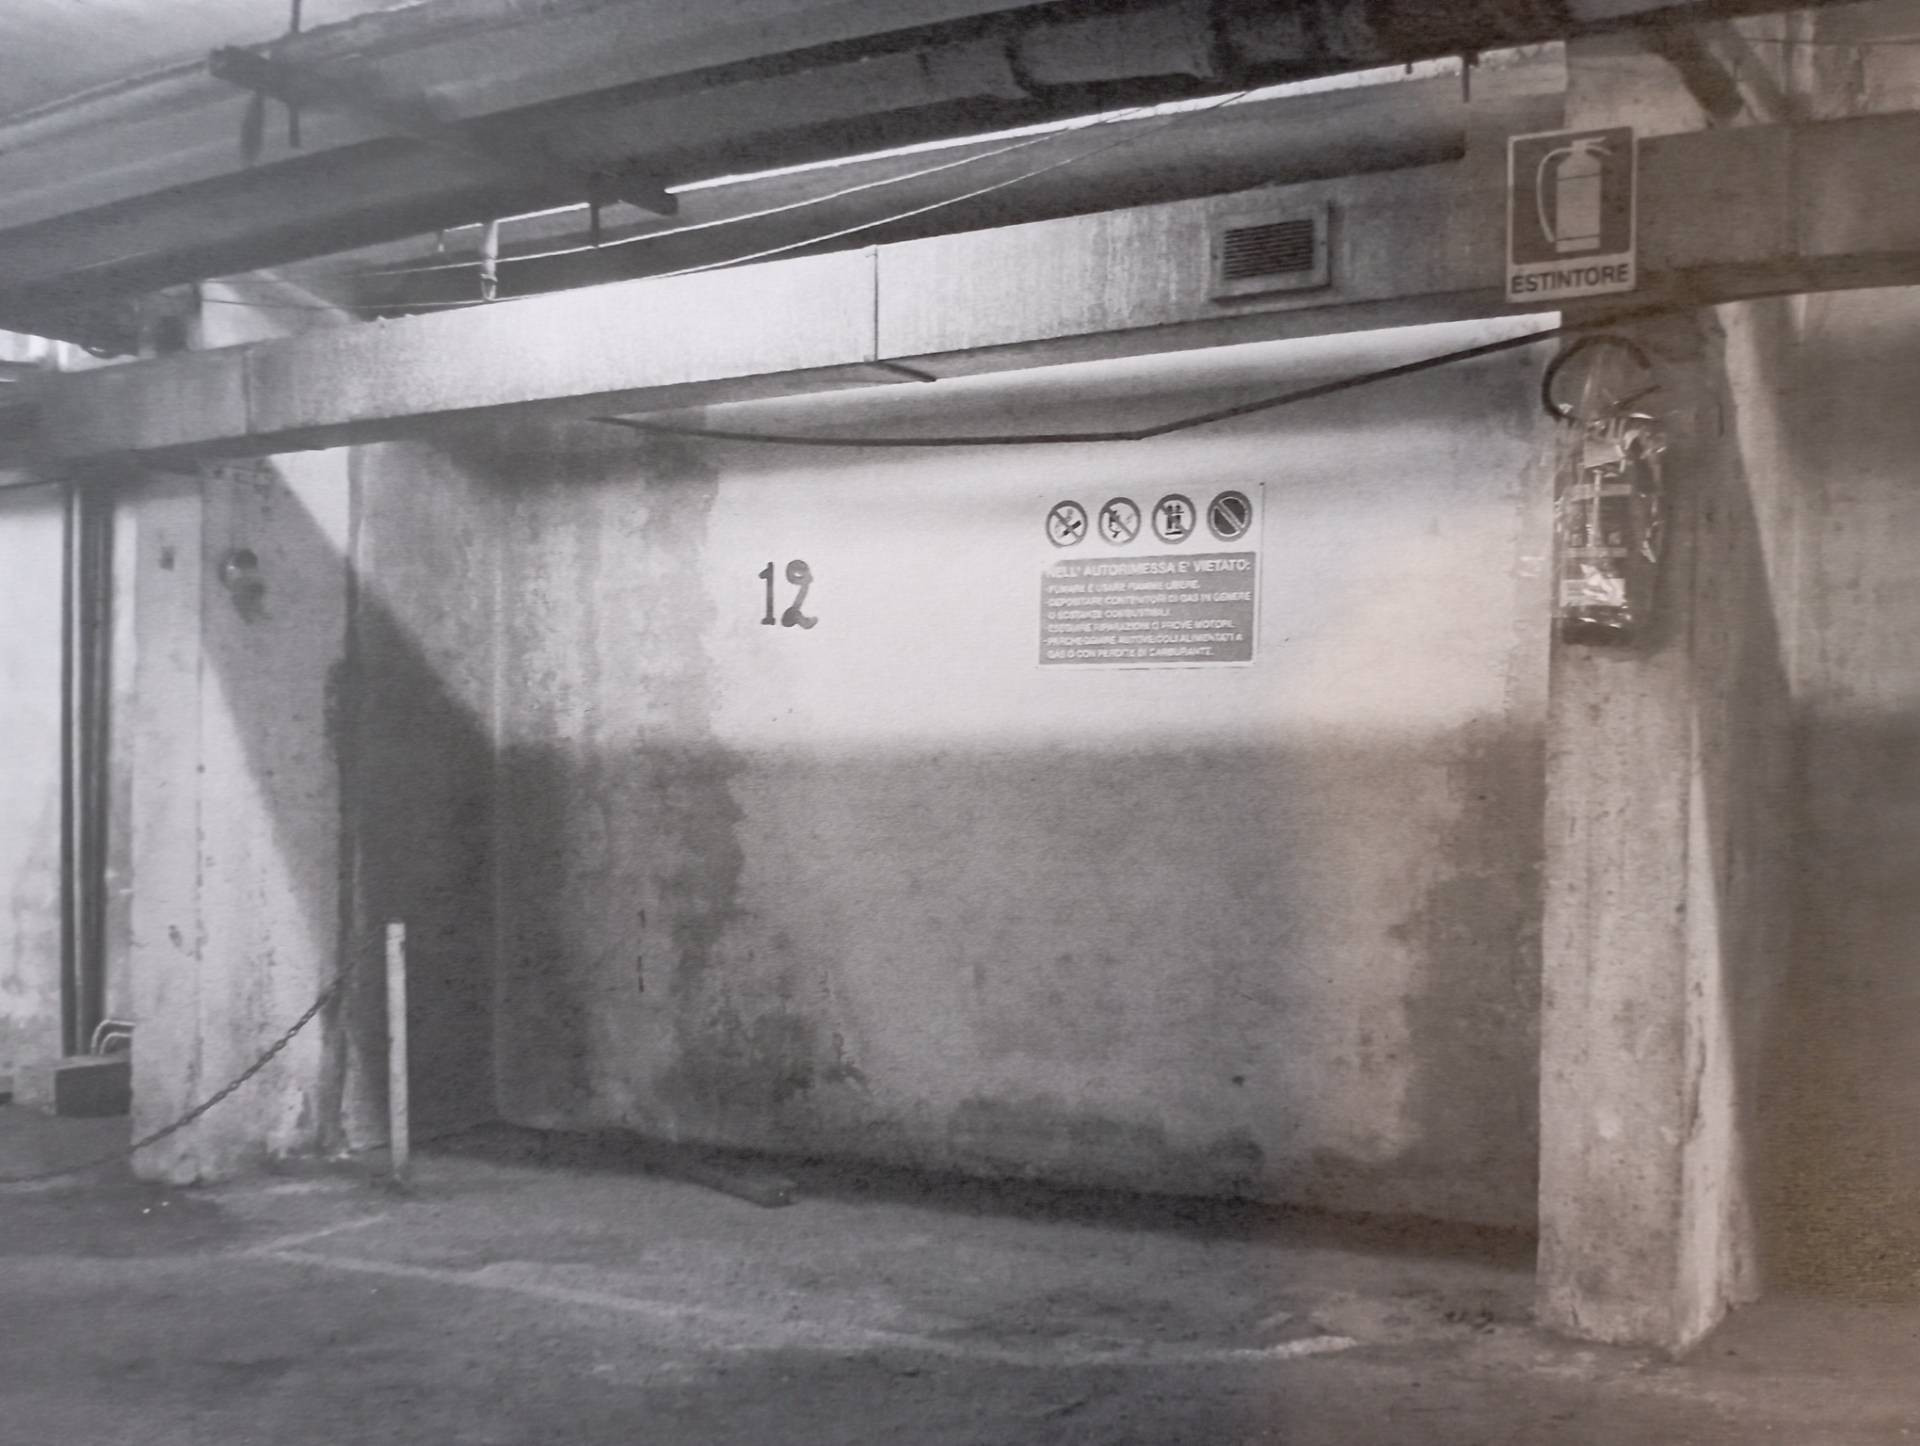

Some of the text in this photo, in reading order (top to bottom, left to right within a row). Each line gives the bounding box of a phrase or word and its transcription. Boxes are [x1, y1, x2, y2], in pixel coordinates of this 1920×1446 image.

[1511, 263, 1629, 293] ESTINTORE
[1084, 562, 1175, 576] AUTORIMESSA
[1193, 559, 1251, 572] VIETATO:
[758, 559, 818, 629] 12
